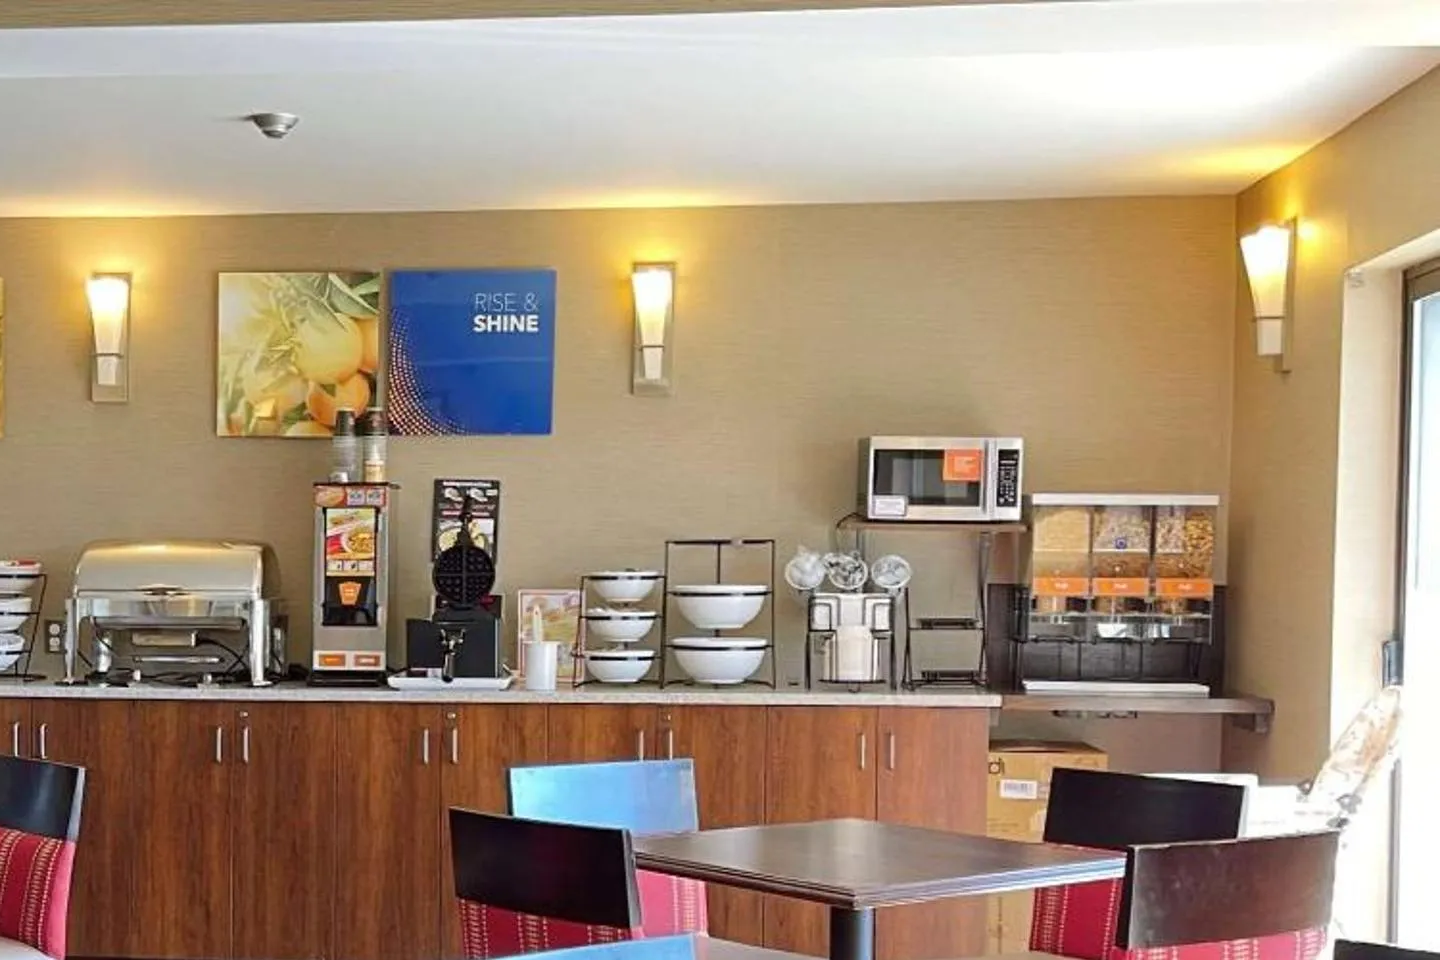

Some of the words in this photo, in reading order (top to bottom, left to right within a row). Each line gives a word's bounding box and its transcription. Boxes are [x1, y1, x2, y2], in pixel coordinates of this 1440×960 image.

[475, 292, 517, 312] RISE
[523, 291, 538, 312] &
[473, 314, 539, 333] SHINE
